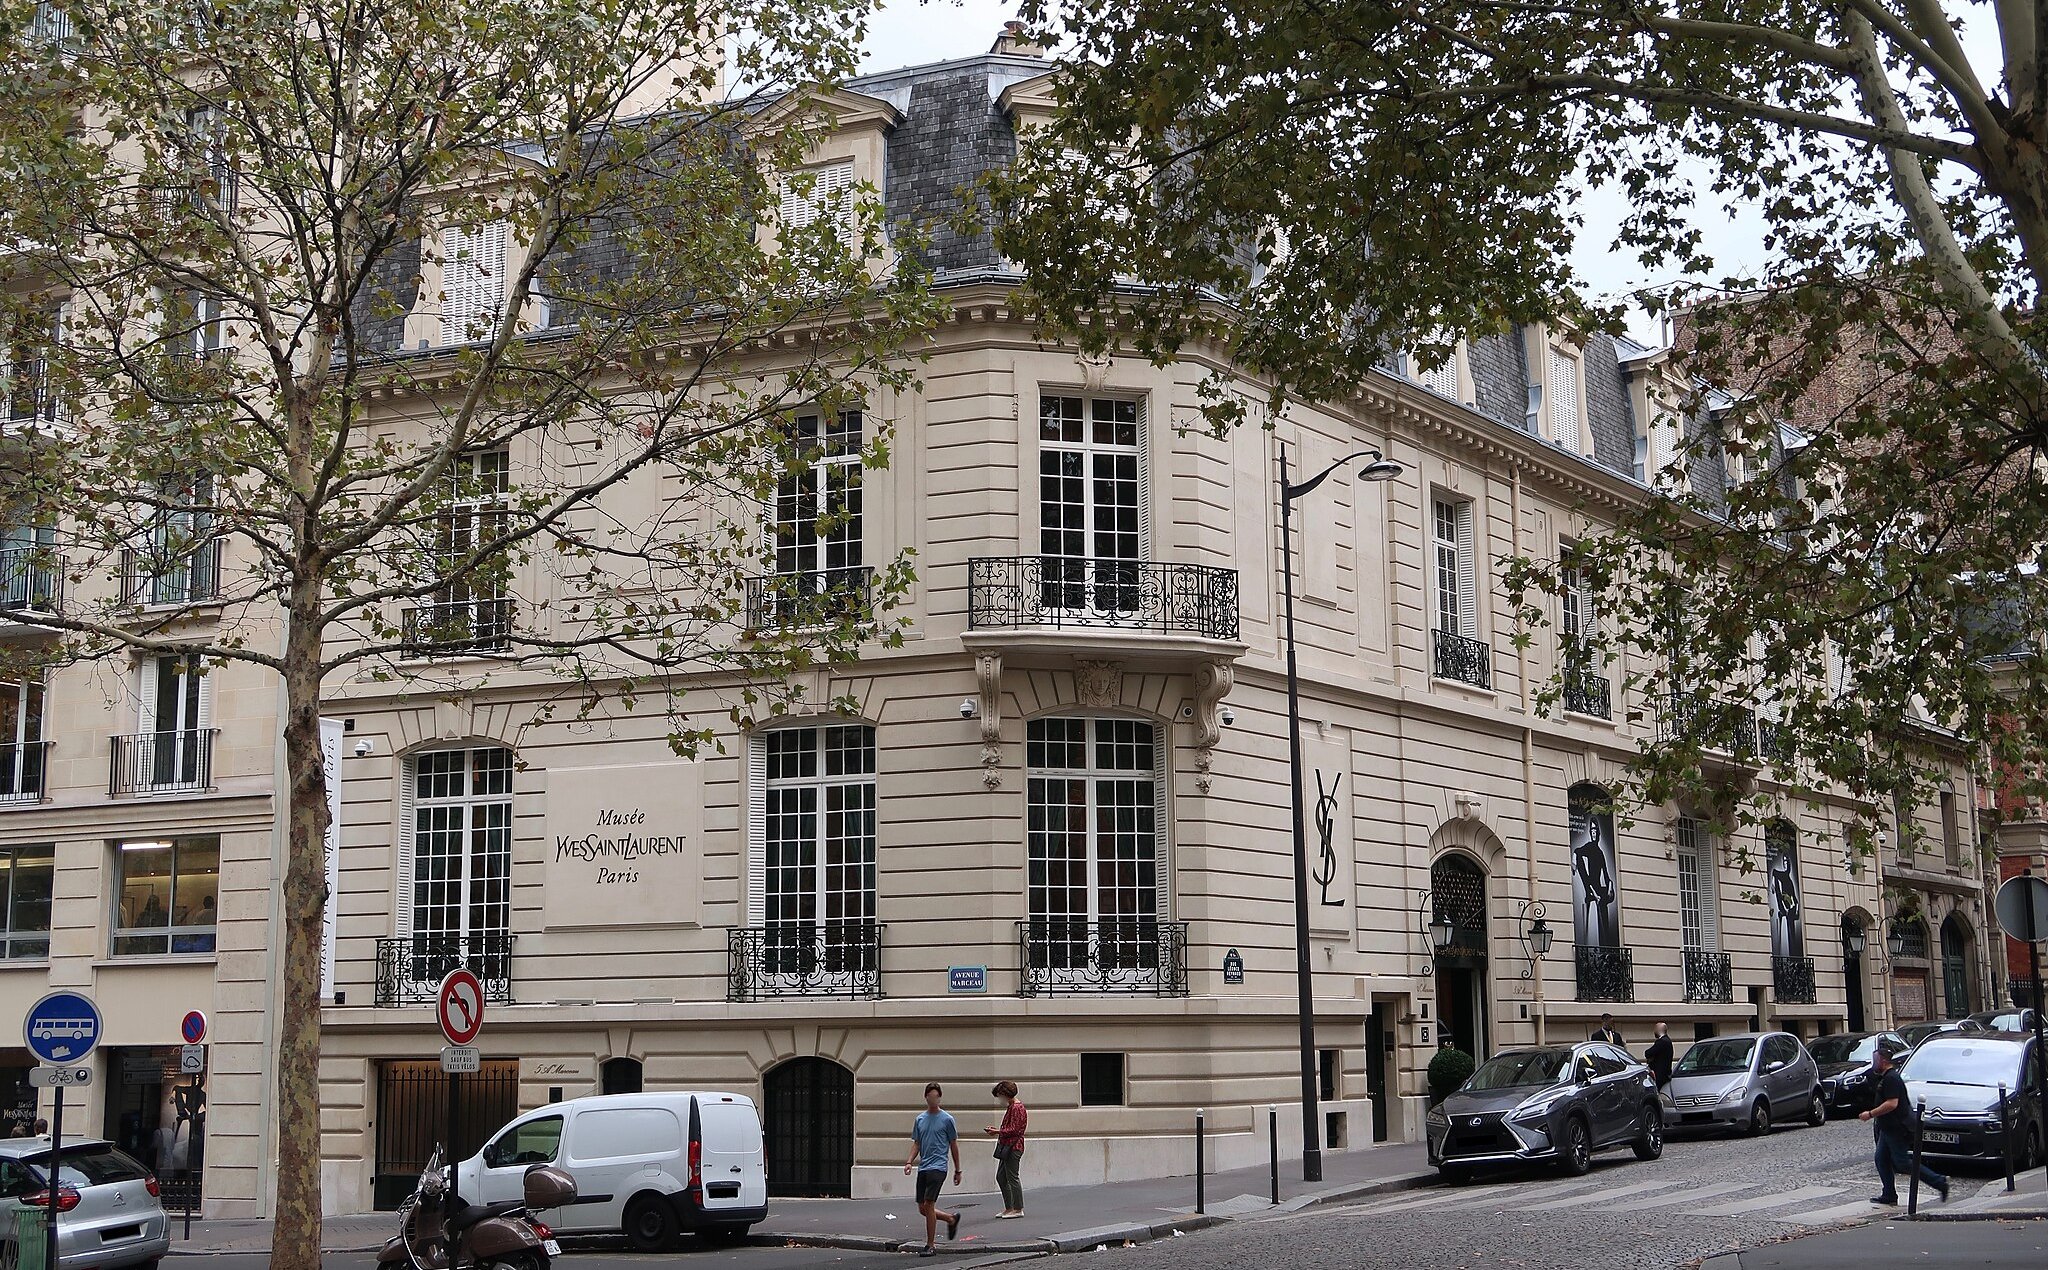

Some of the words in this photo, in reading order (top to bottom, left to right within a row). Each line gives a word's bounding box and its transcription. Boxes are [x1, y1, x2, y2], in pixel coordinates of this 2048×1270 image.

[323, 736, 335, 781] Paris
[597, 808, 645, 826] Musée
[1313, 768, 1346, 907] YSL
[597, 866, 640, 884] Paris
